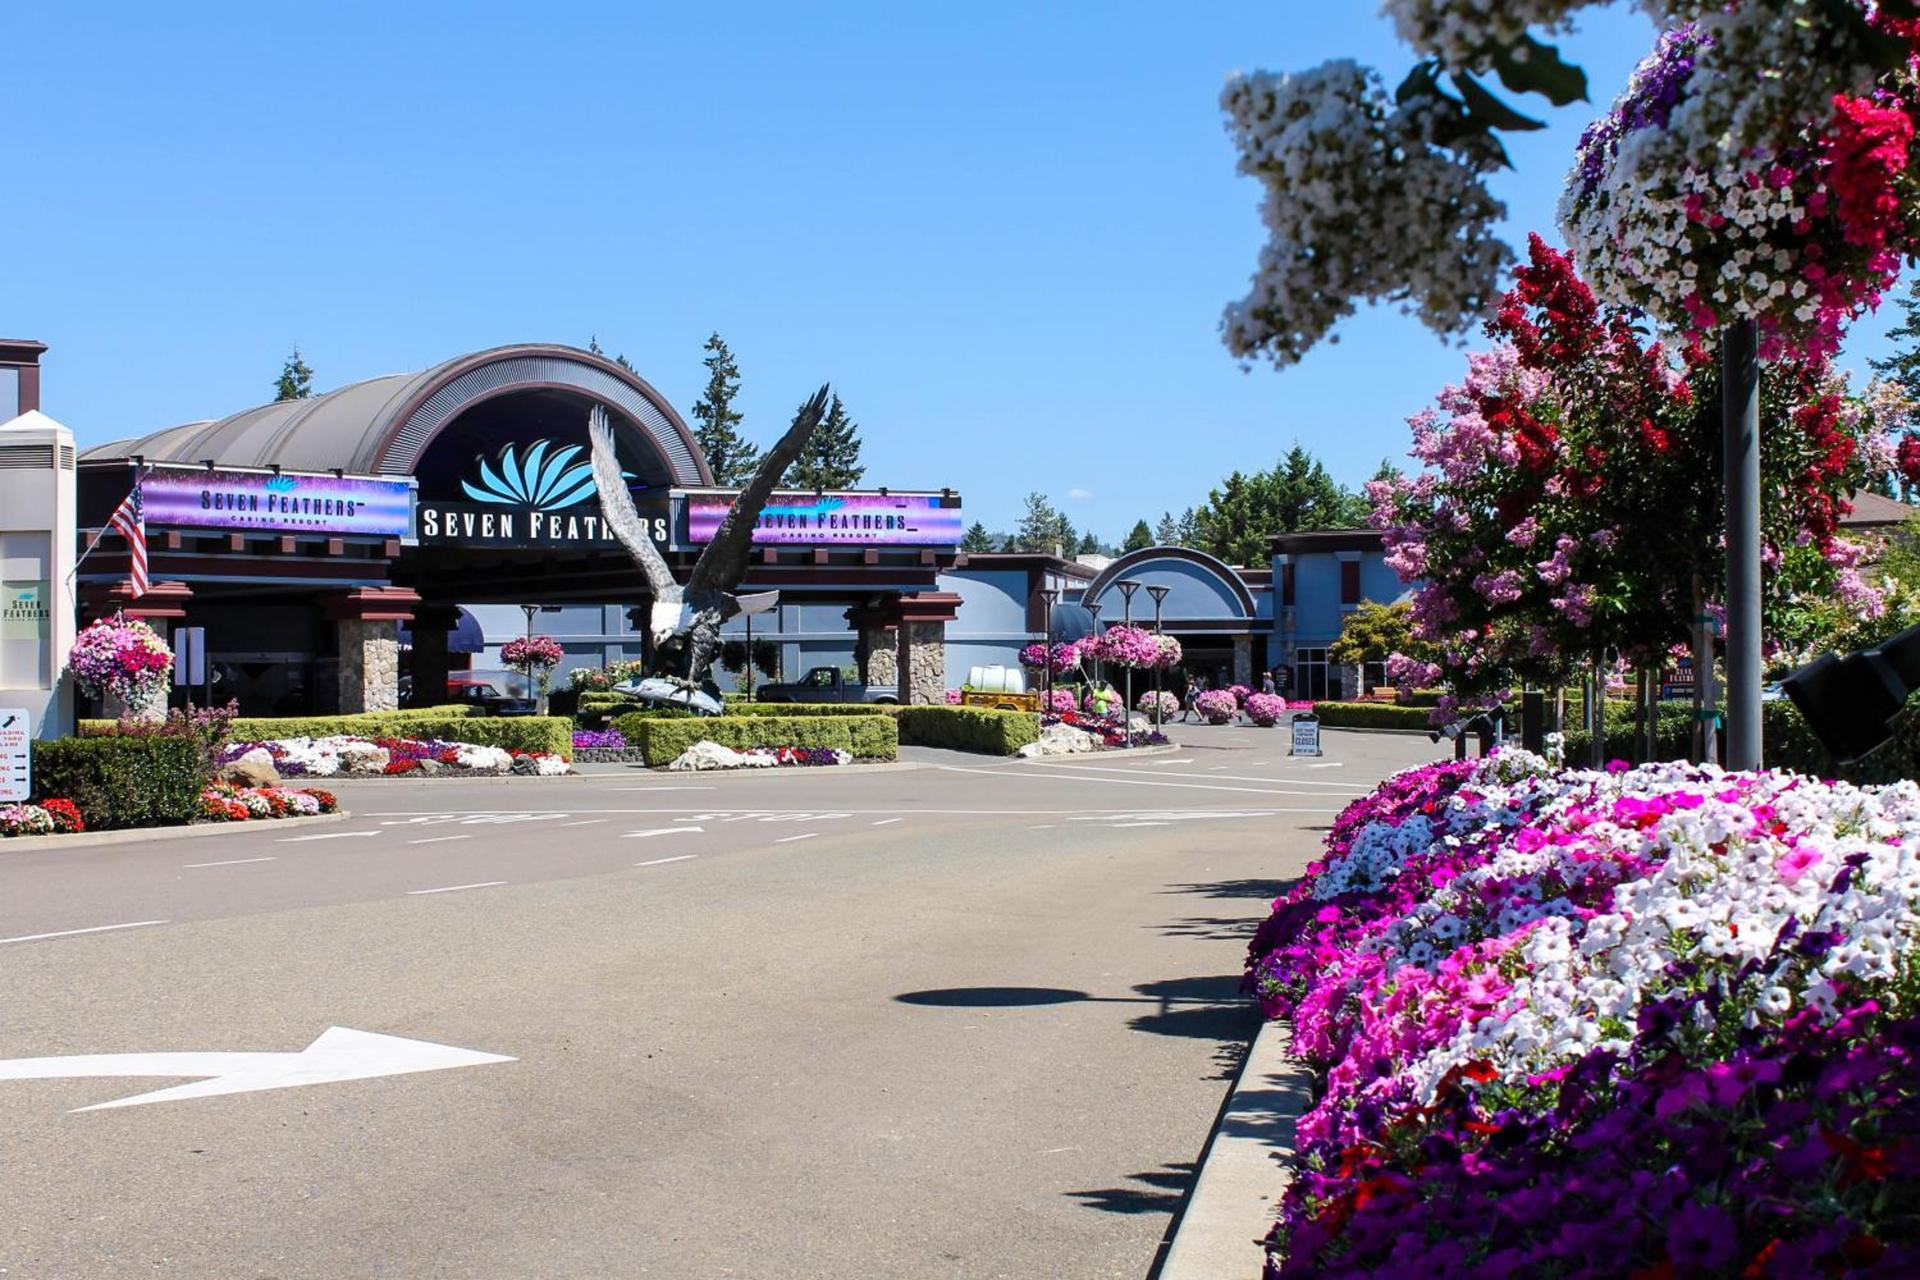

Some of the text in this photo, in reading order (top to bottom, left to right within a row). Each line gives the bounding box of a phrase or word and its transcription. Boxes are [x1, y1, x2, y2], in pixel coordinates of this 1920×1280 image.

[201, 490, 355, 517] SEVEN FEATHERS
[231, 515, 327, 526] CASINO RESORT
[423, 508, 668, 542] SEVEN FEATHRS
[817, 512, 906, 529] FEATHERS
[673, 813, 853, 822] STOP
